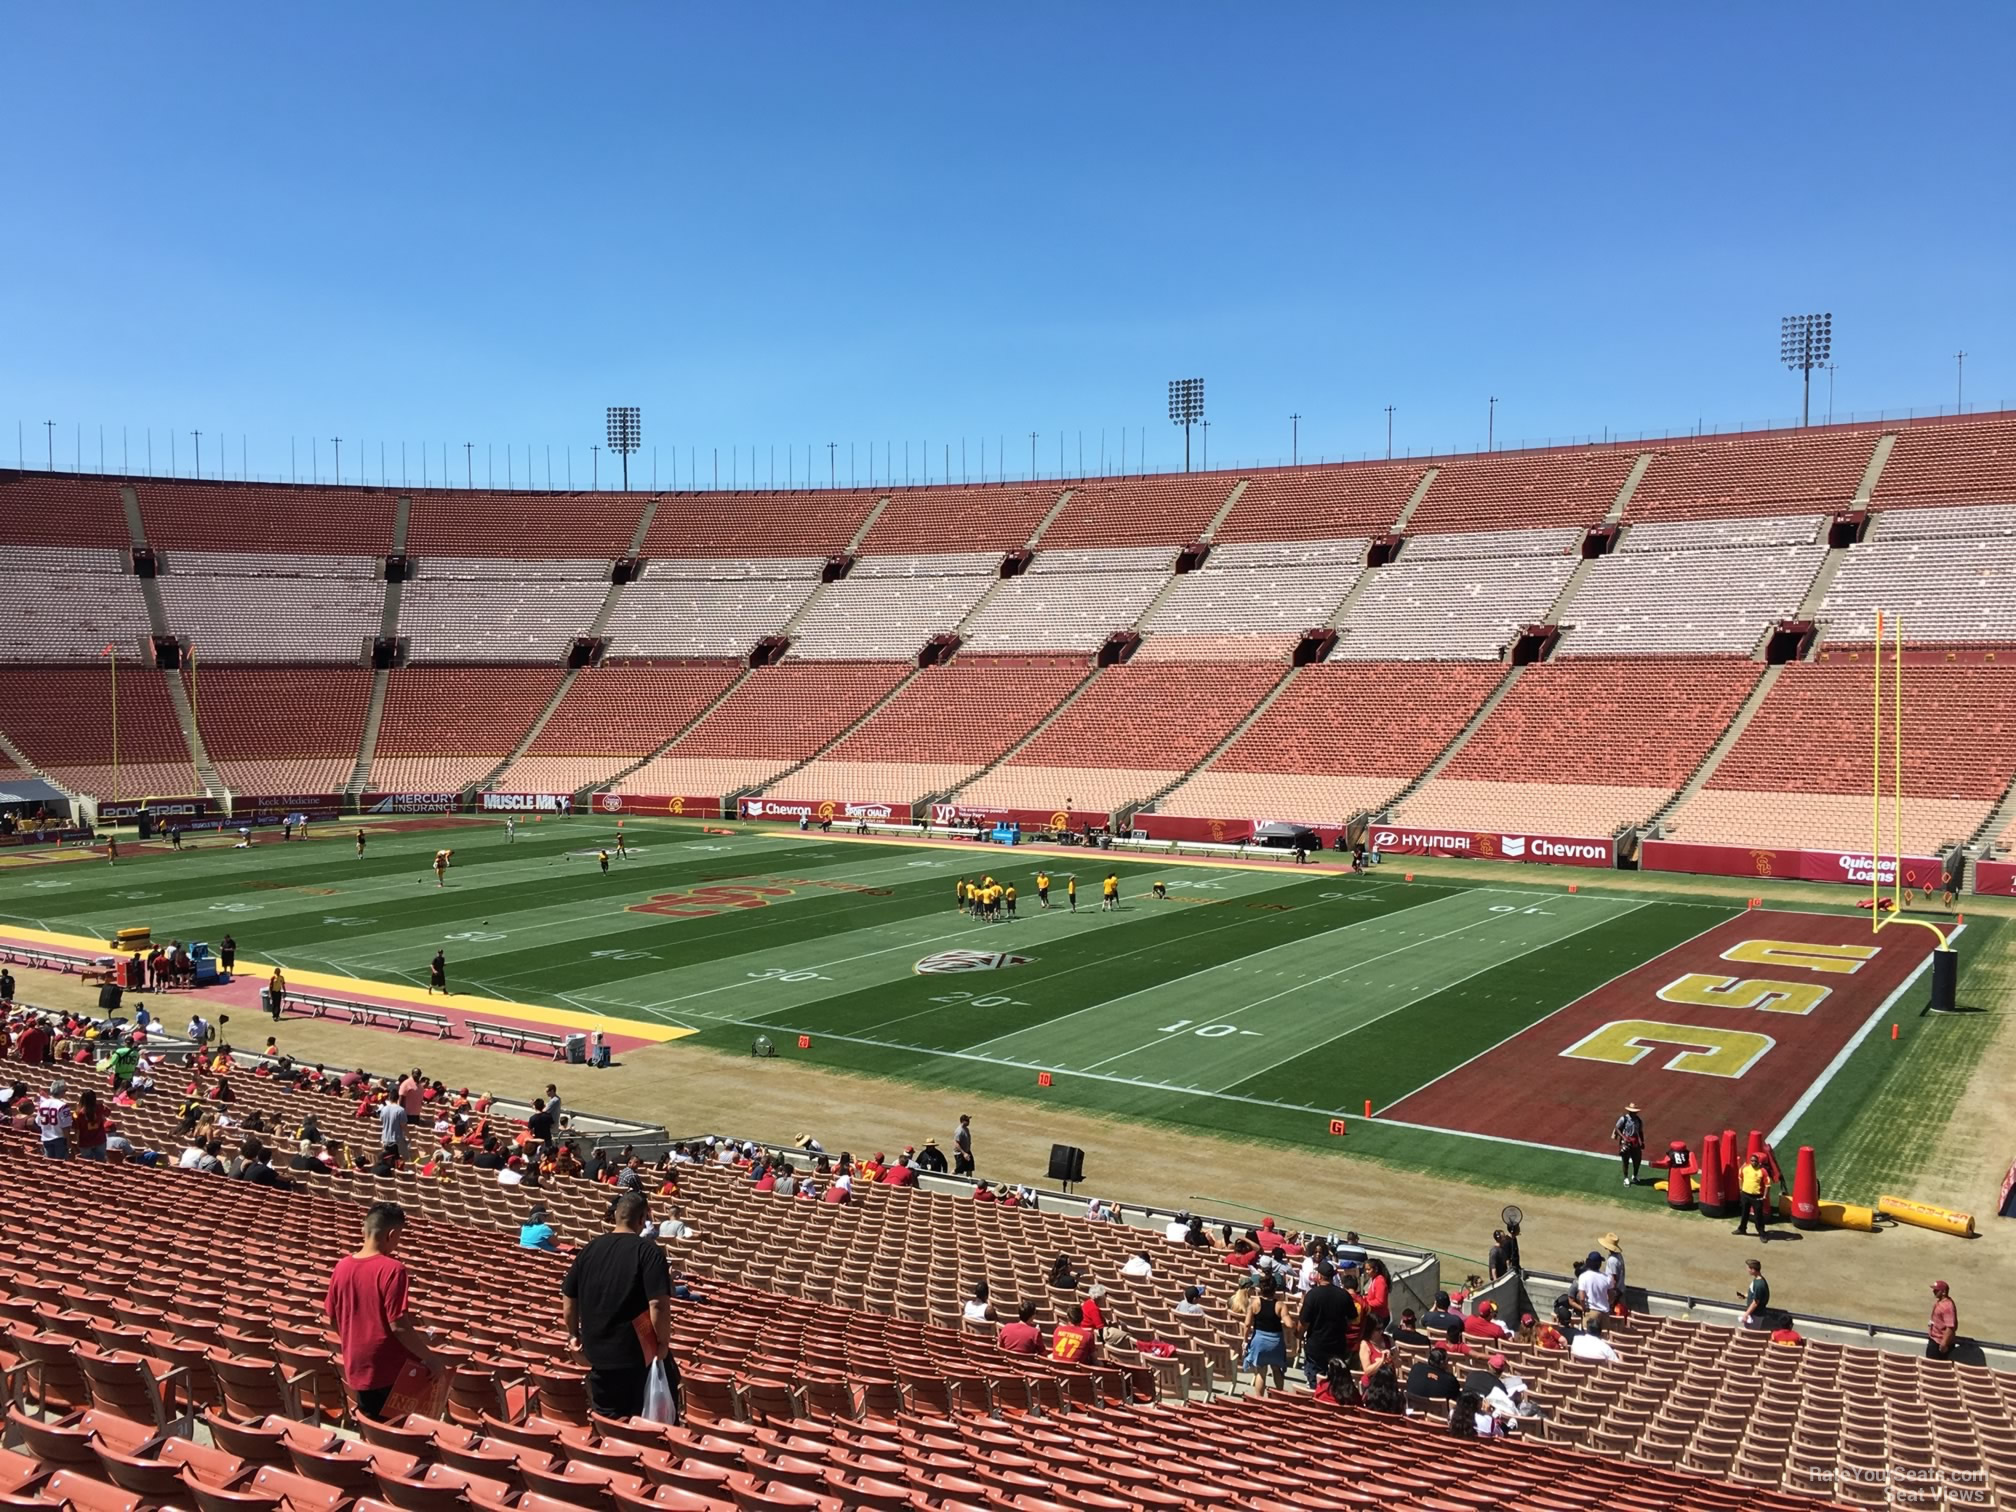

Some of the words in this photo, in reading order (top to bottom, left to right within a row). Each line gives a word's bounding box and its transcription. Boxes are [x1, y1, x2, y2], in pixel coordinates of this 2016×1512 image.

[258, 797, 280, 806] Keck
[282, 796, 320, 806] Medicine
[395, 794, 457, 803] MERCURY
[484, 794, 534, 810] MUSCLE
[395, 803, 457, 812] INSURANCE
[765, 803, 812, 816] Chevron
[845, 808, 866, 817] SPORT
[867, 809, 891, 818] CHALET
[936, 805, 955, 824] yp
[1402, 834, 1470, 849] HYUNDAI
[1531, 839, 1606, 859] Chevron
[1839, 855, 1899, 871] Quicken
[1848, 868, 1894, 882] Loans
[746, 968, 819, 981] 30
[928, 991, 1011, 1007] 20
[1558, 938, 1882, 1078] USC
[1157, 1020, 1238, 1037] 10
[1040, 1074, 1050, 1085] 10
[40, 1108, 57, 1126] 58
[1331, 1121, 1343, 1134] G
[863, 1169, 876, 1181] 21
[1055, 1337, 1080, 1359] 47
